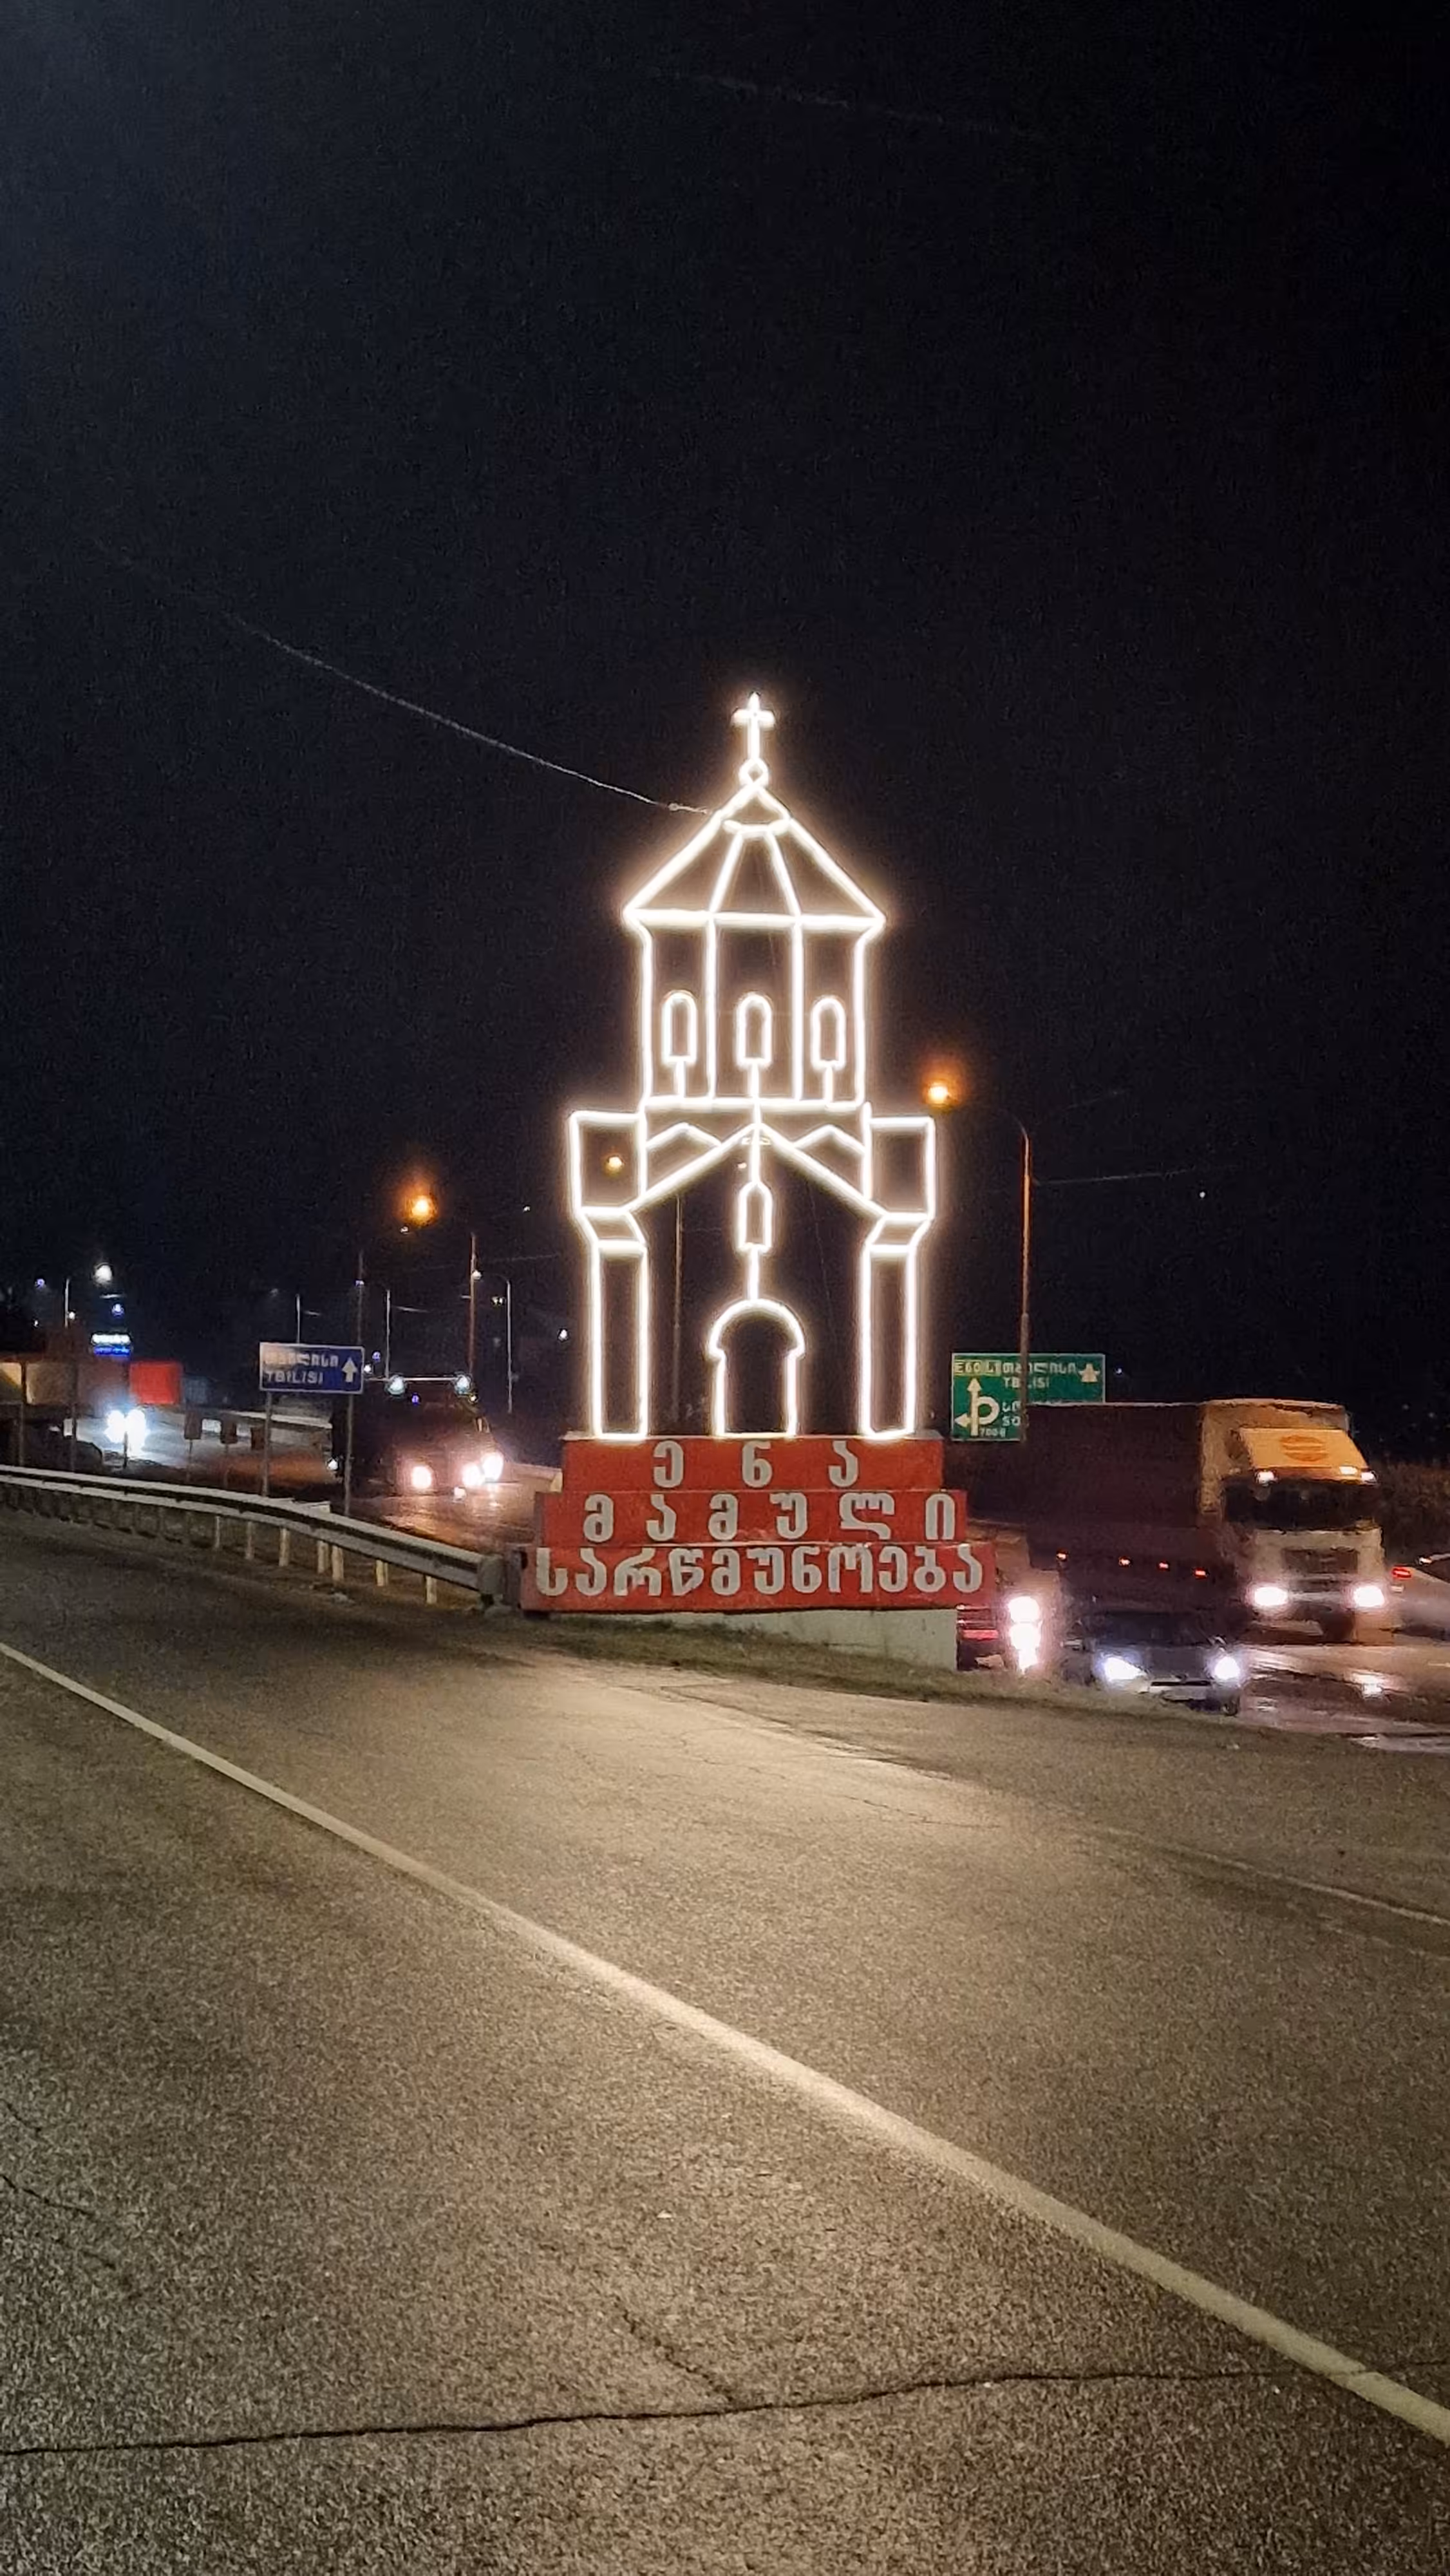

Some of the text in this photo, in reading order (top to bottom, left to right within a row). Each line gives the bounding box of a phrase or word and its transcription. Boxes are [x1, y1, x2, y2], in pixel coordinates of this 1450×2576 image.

[265, 1370, 324, 1384] TBILISI
[1002, 1376, 1050, 1388] TBISI
[653, 1440, 859, 1488] ენა
[583, 1492, 956, 1542] მამული
[535, 1546, 983, 1596] სარწმუნოება
